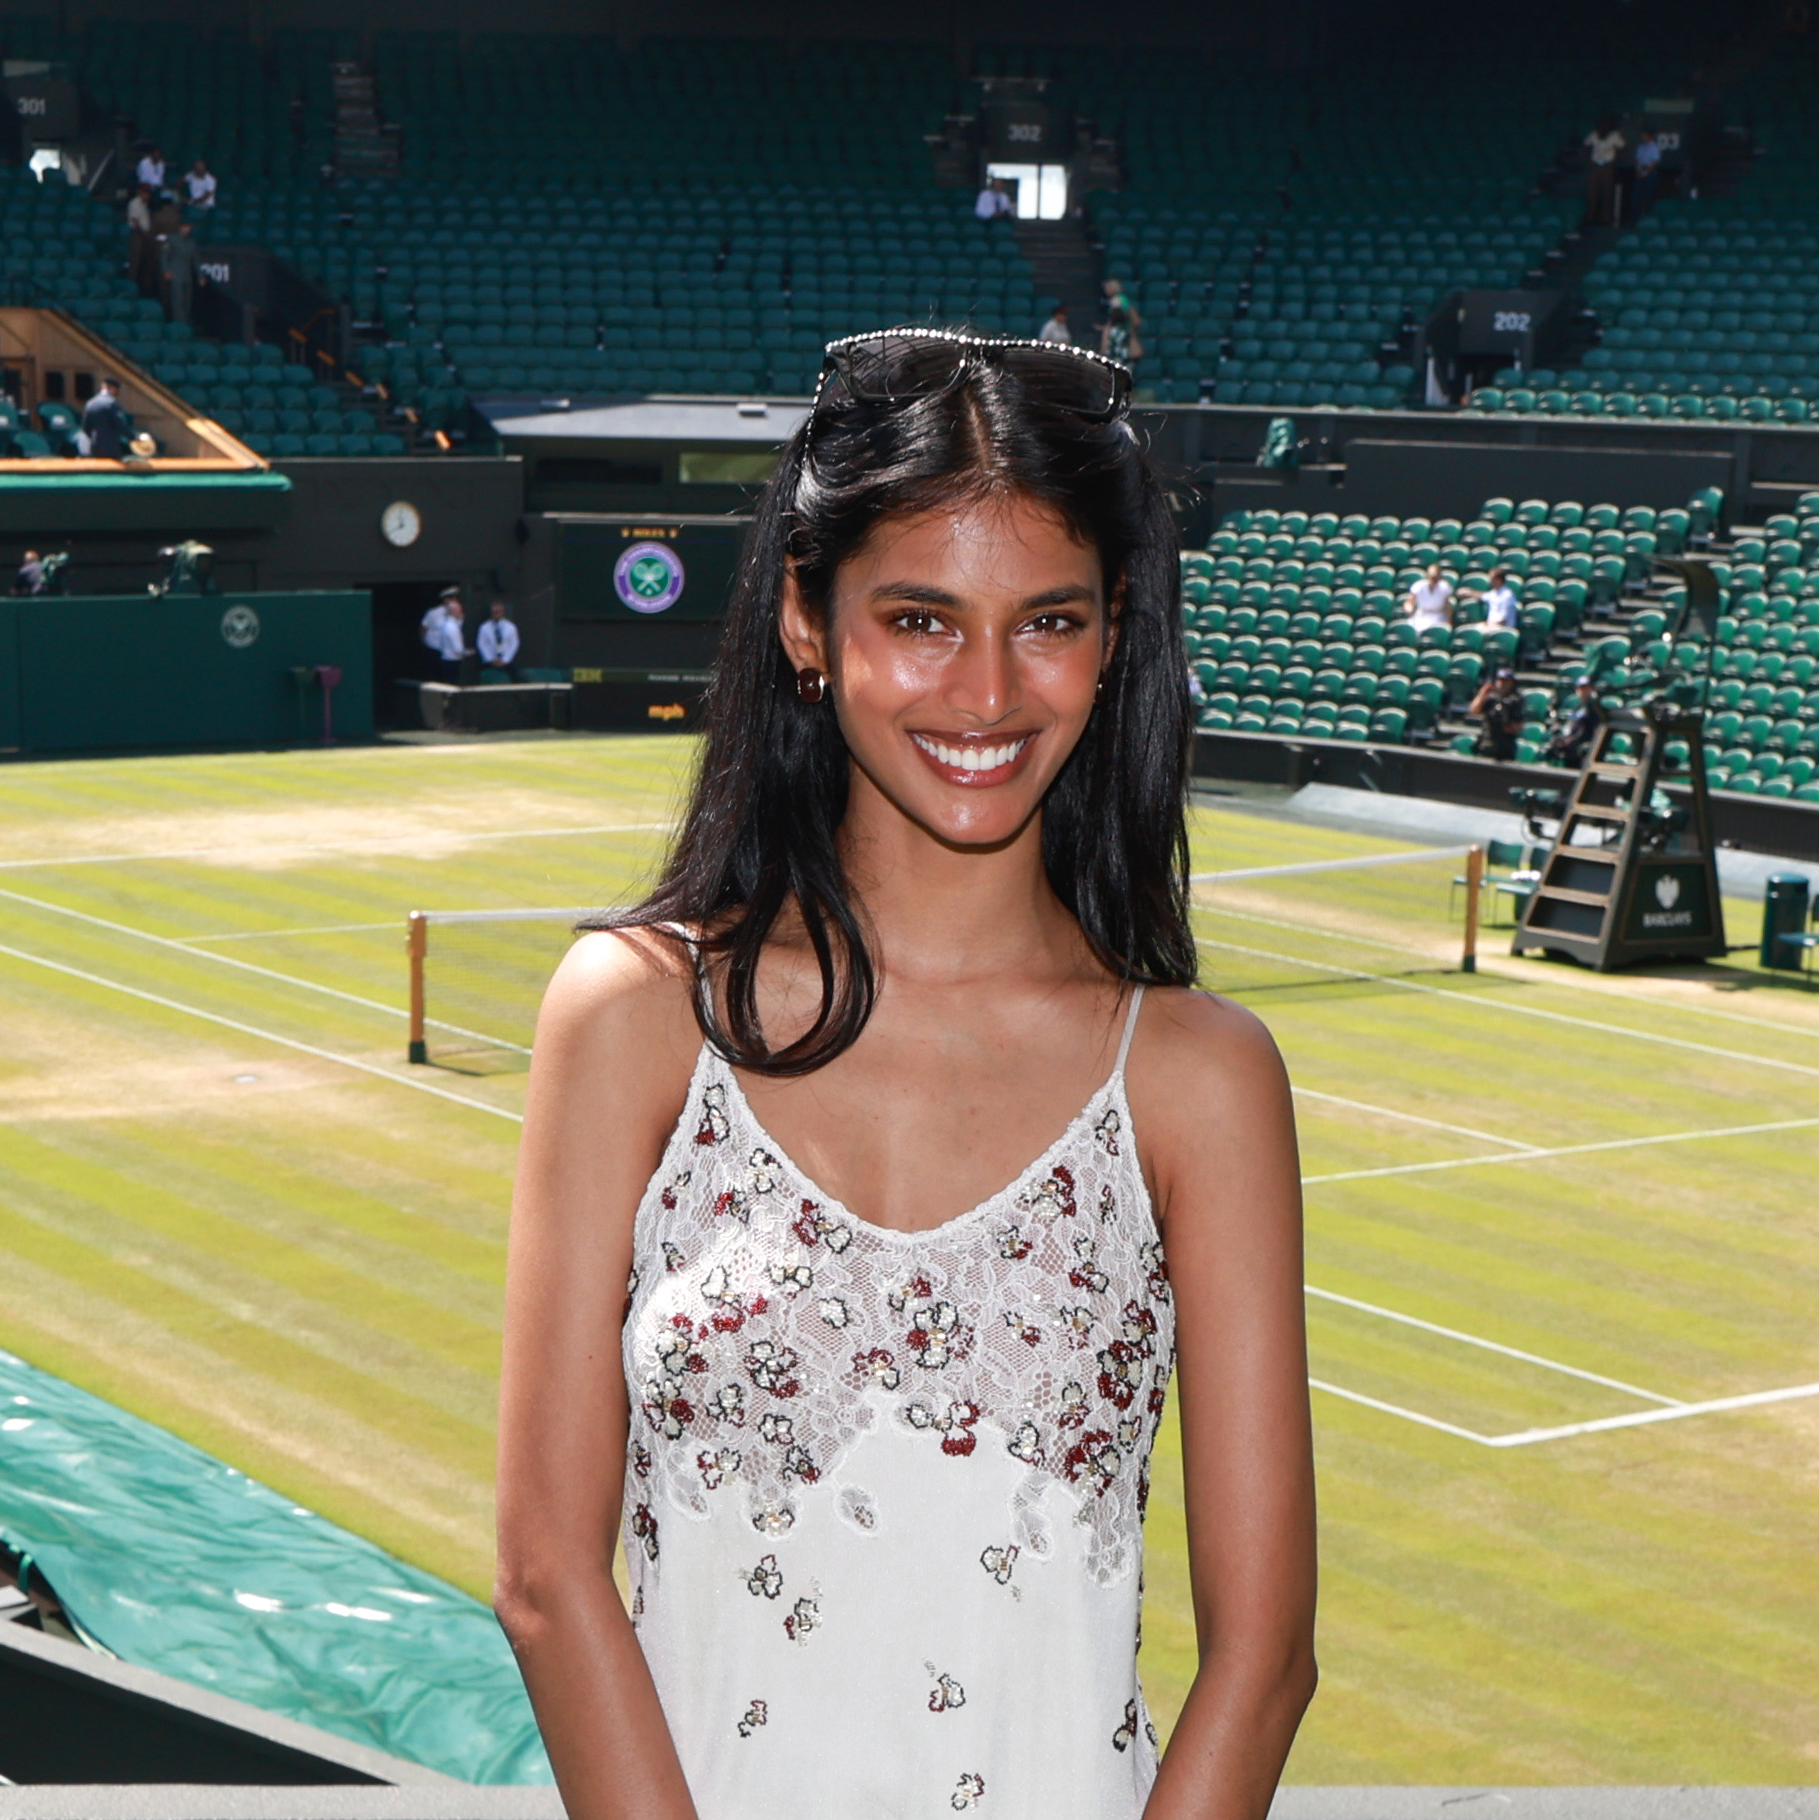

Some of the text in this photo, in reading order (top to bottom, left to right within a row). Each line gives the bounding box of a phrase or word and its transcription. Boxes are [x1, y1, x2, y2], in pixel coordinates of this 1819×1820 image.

[17, 97, 46, 116] 301
[1008, 123, 1041, 142] 302
[1494, 311, 1531, 331] 202
[648, 703, 685, 722] mph
